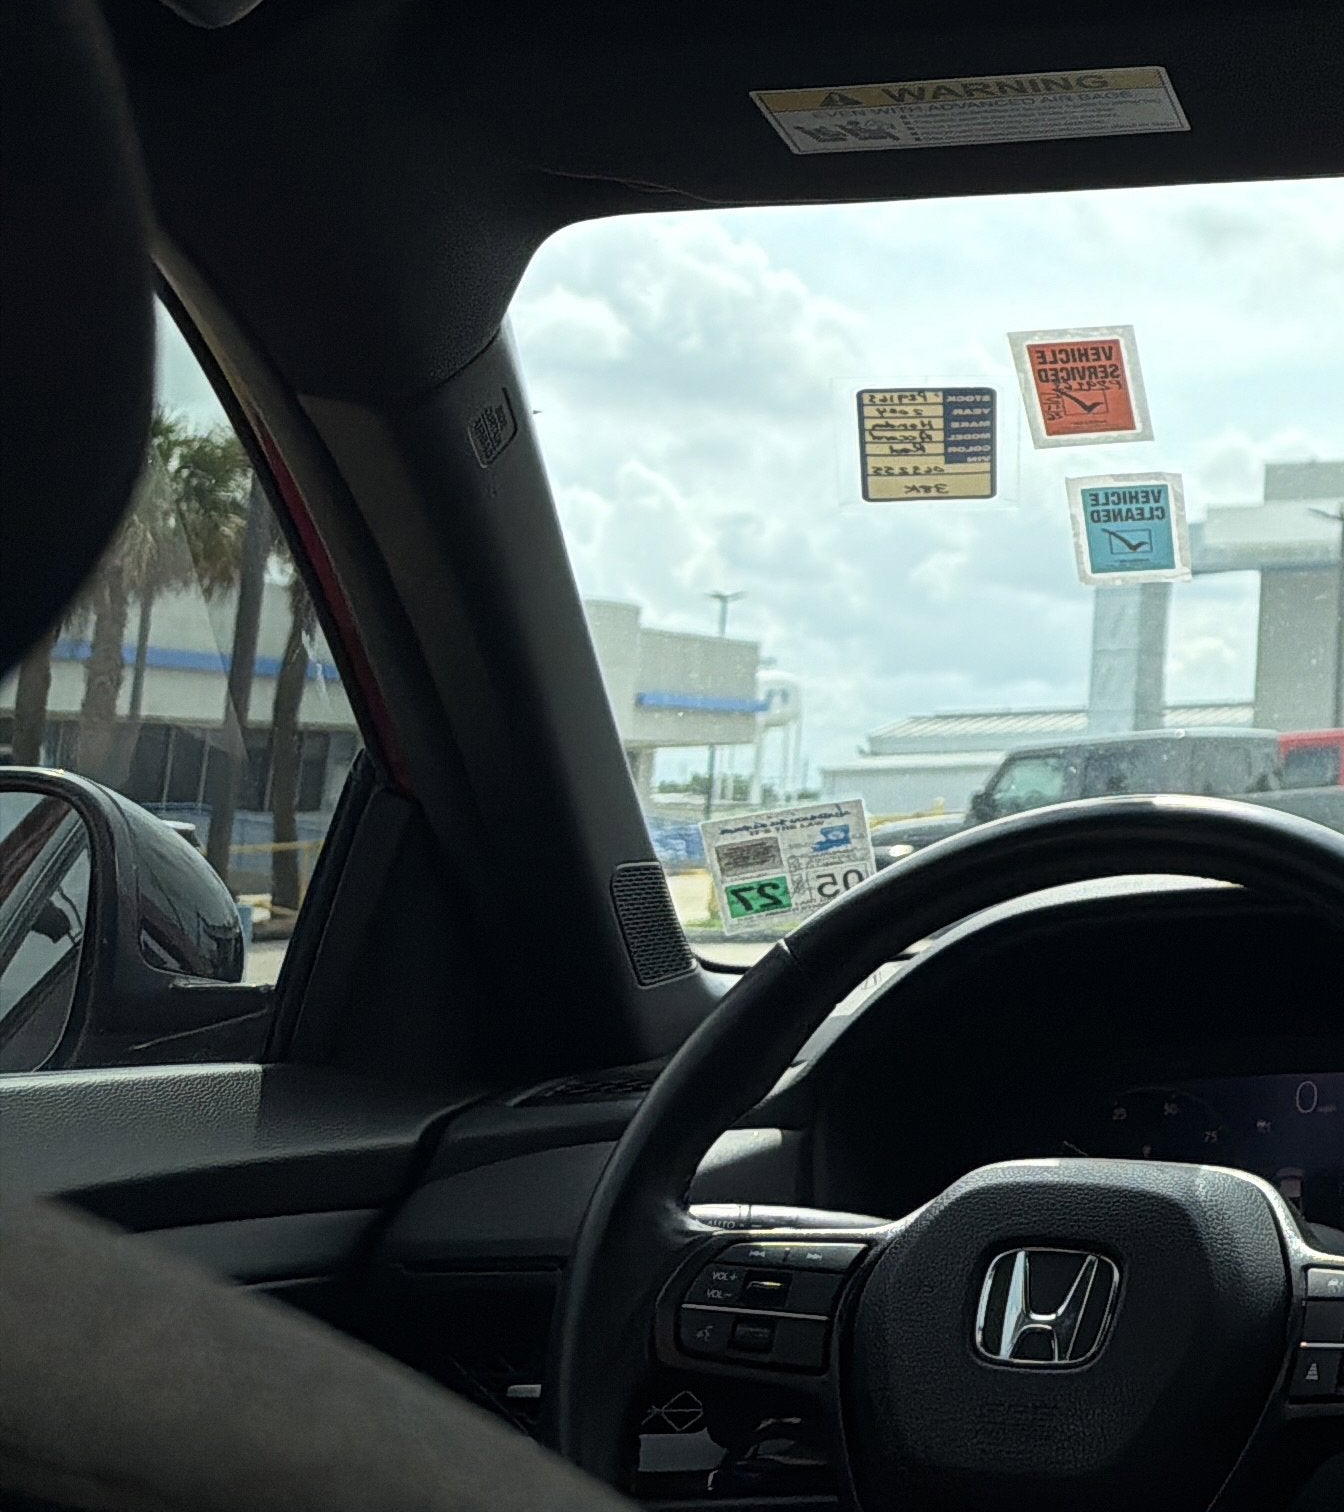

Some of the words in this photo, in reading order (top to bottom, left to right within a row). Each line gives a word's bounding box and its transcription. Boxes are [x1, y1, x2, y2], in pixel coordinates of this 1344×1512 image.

[882, 74, 1109, 103] WARNING
[1041, 94, 1073, 103] AIR
[1078, 90, 1133, 101] BAGS
